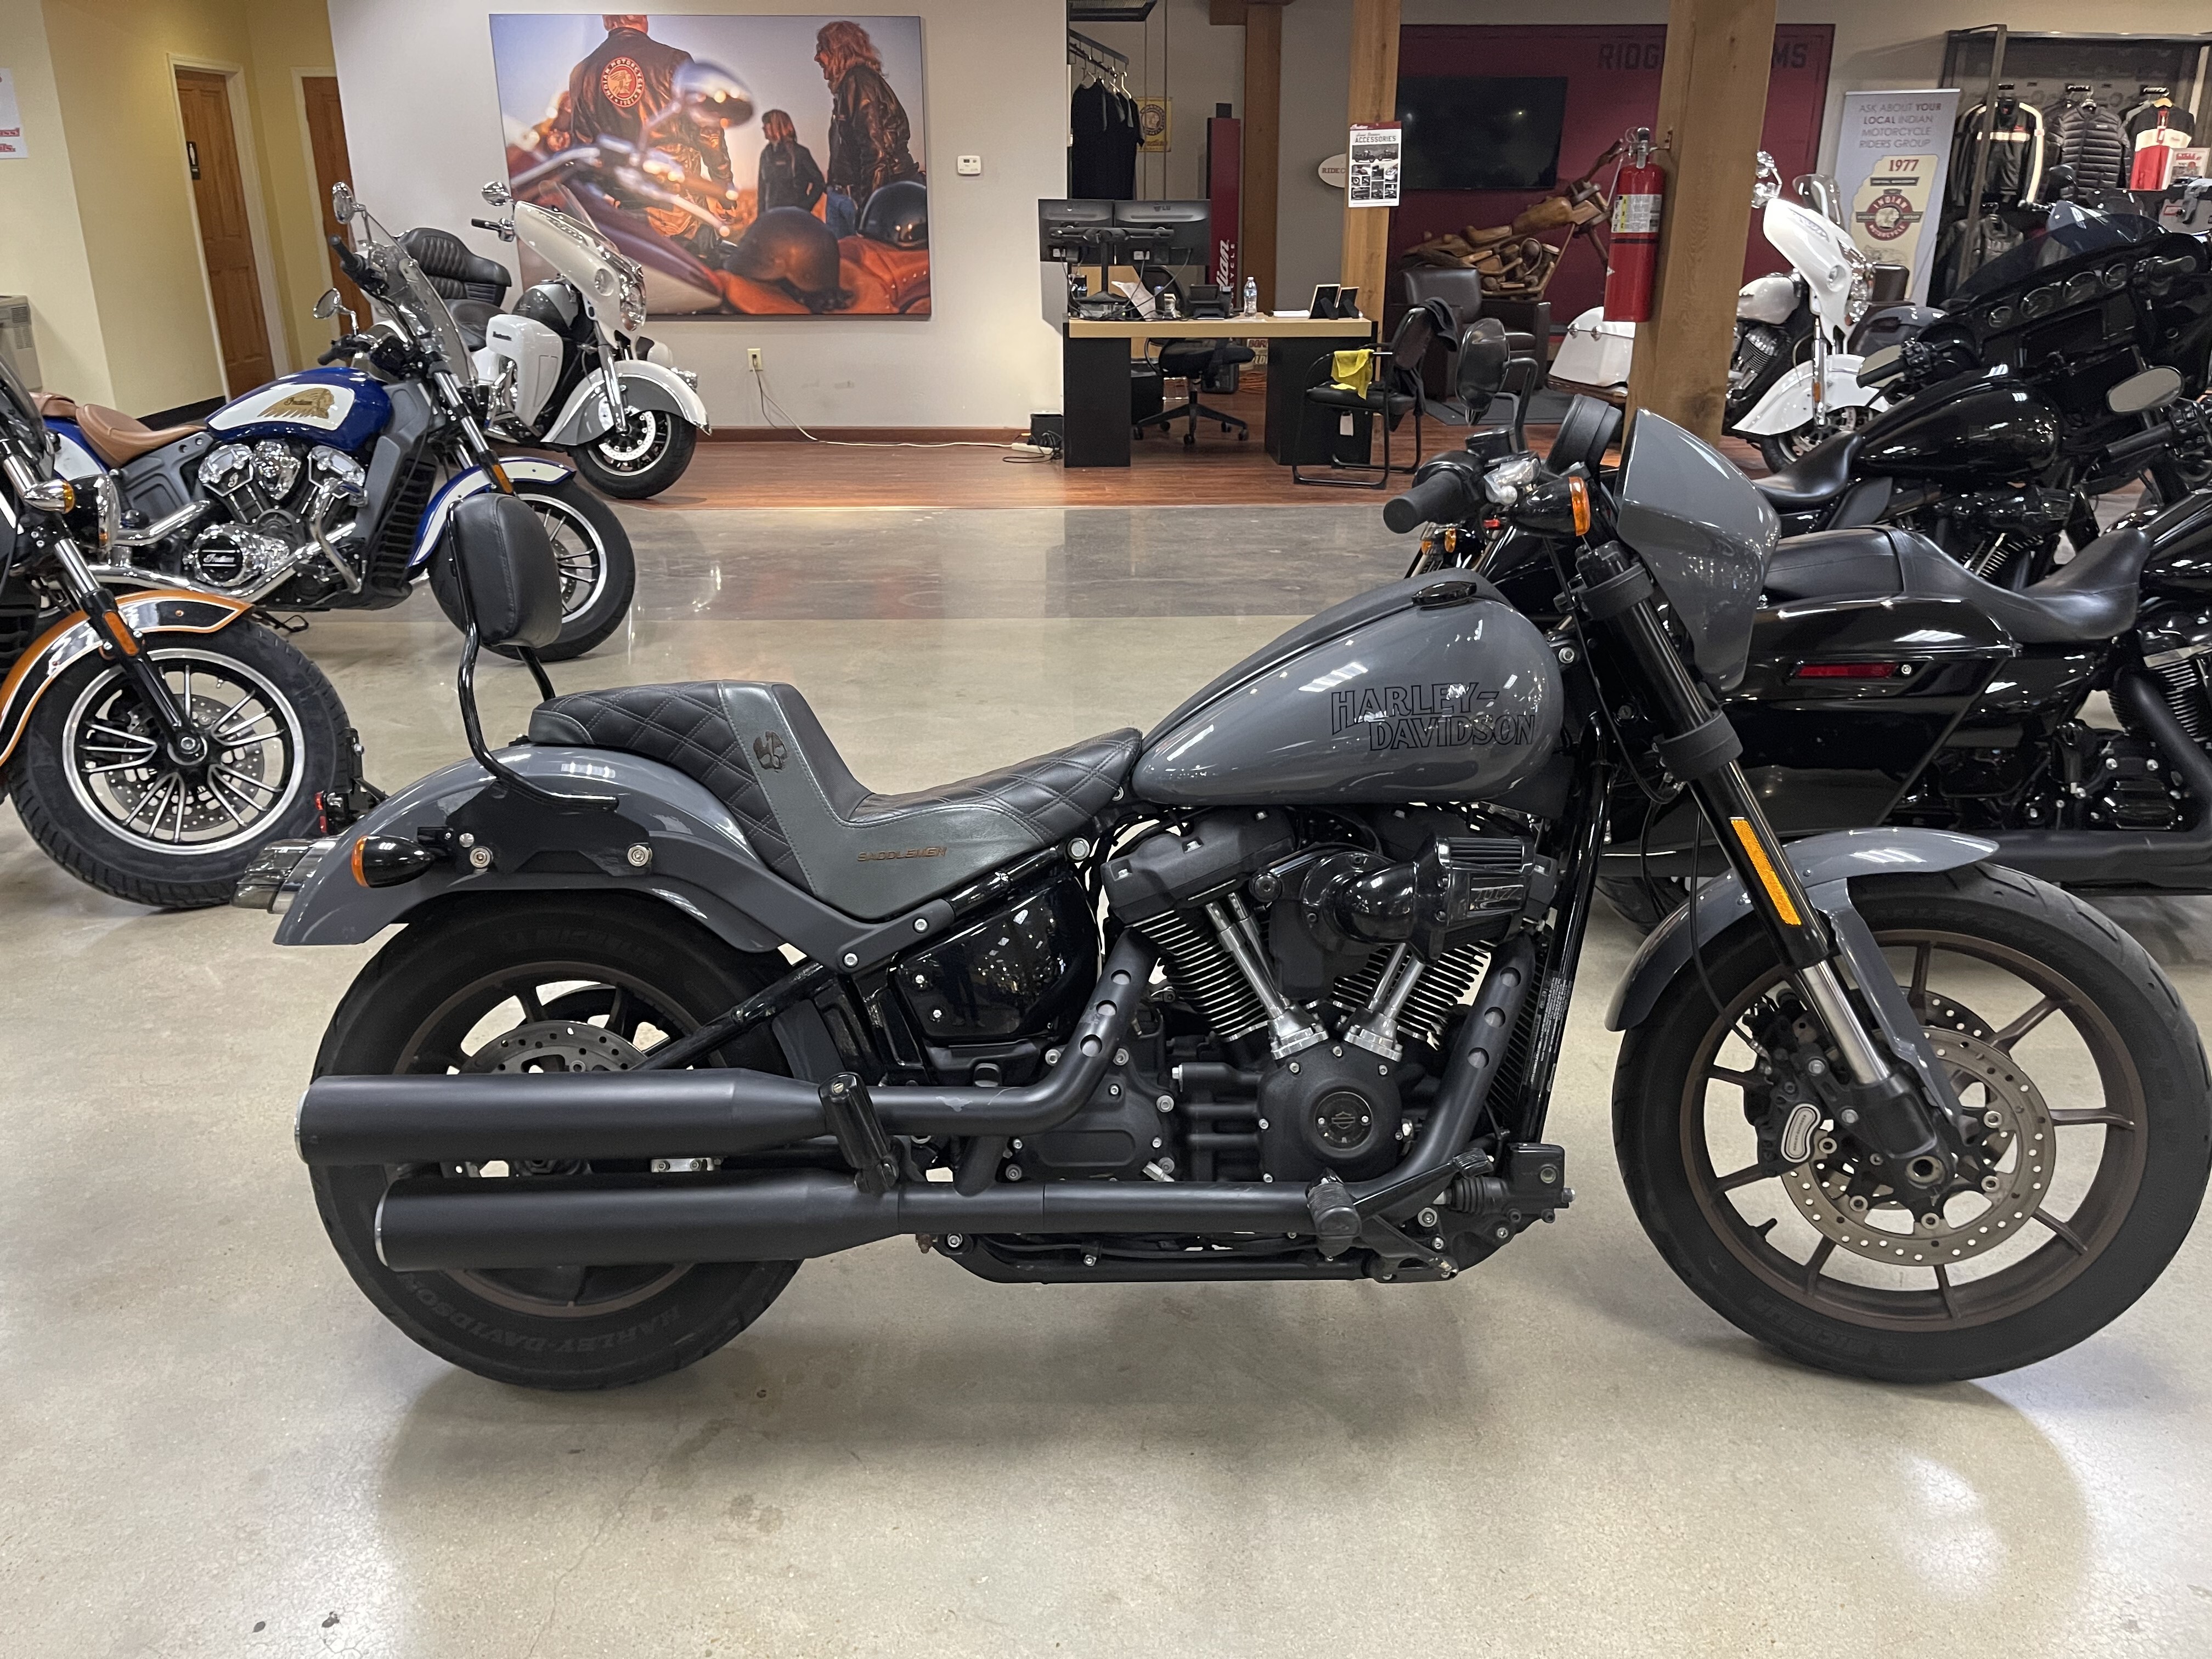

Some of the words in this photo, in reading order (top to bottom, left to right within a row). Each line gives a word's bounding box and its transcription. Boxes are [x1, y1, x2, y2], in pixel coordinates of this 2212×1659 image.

[1598, 43, 1660, 70] RIDG
[602, 67, 614, 99] INDIAN
[1860, 104, 1877, 112] ASK
[1880, 103, 1913, 112] ABOUT
[1915, 103, 1942, 111] YOUR
[1864, 116, 1895, 125] LOCAL
[1898, 115, 1933, 124] INDIAN
[1861, 127, 1932, 137] MOTORCYCLE
[1859, 139, 1891, 148] RIDERS
[1894, 138, 1931, 148] GROUP
[1888, 159, 1920, 172] 1977
[1873, 196, 1908, 209] INDIAN
[1331, 682, 1500, 736] HARLEY-
[1369, 714, 1536, 751] DAVIDSON
[857, 846, 947, 862] SADDLEMEN
